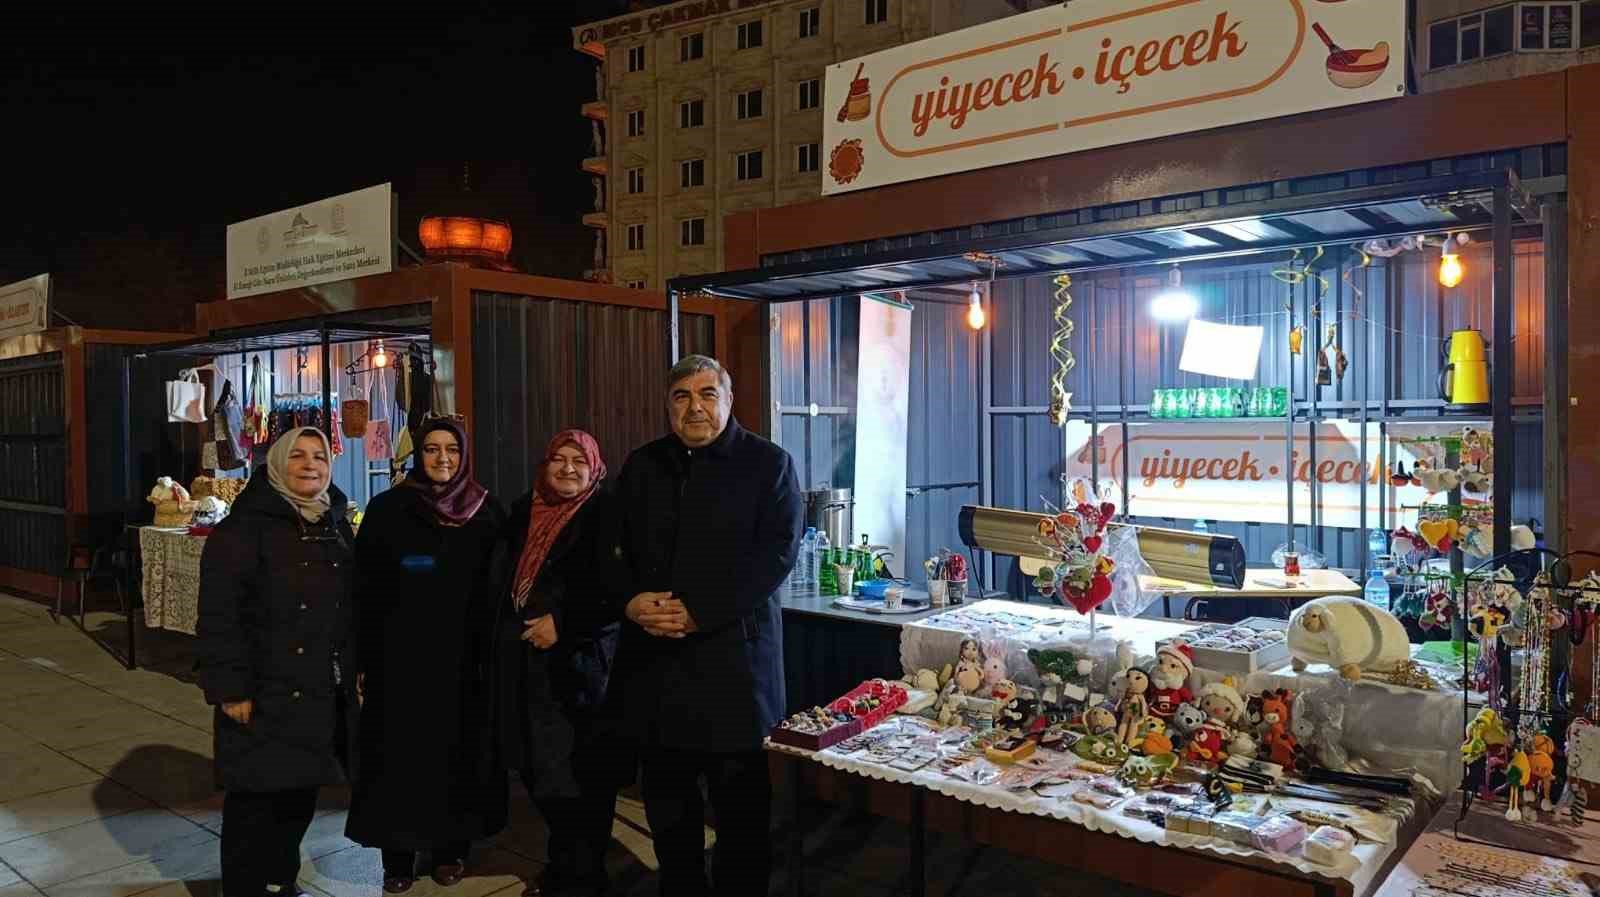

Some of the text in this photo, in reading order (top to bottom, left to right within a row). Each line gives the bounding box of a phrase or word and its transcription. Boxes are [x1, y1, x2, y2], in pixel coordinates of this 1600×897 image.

[911, 11, 1248, 137] yiyecek içecek
[1140, 449, 1263, 488] yiyecek
